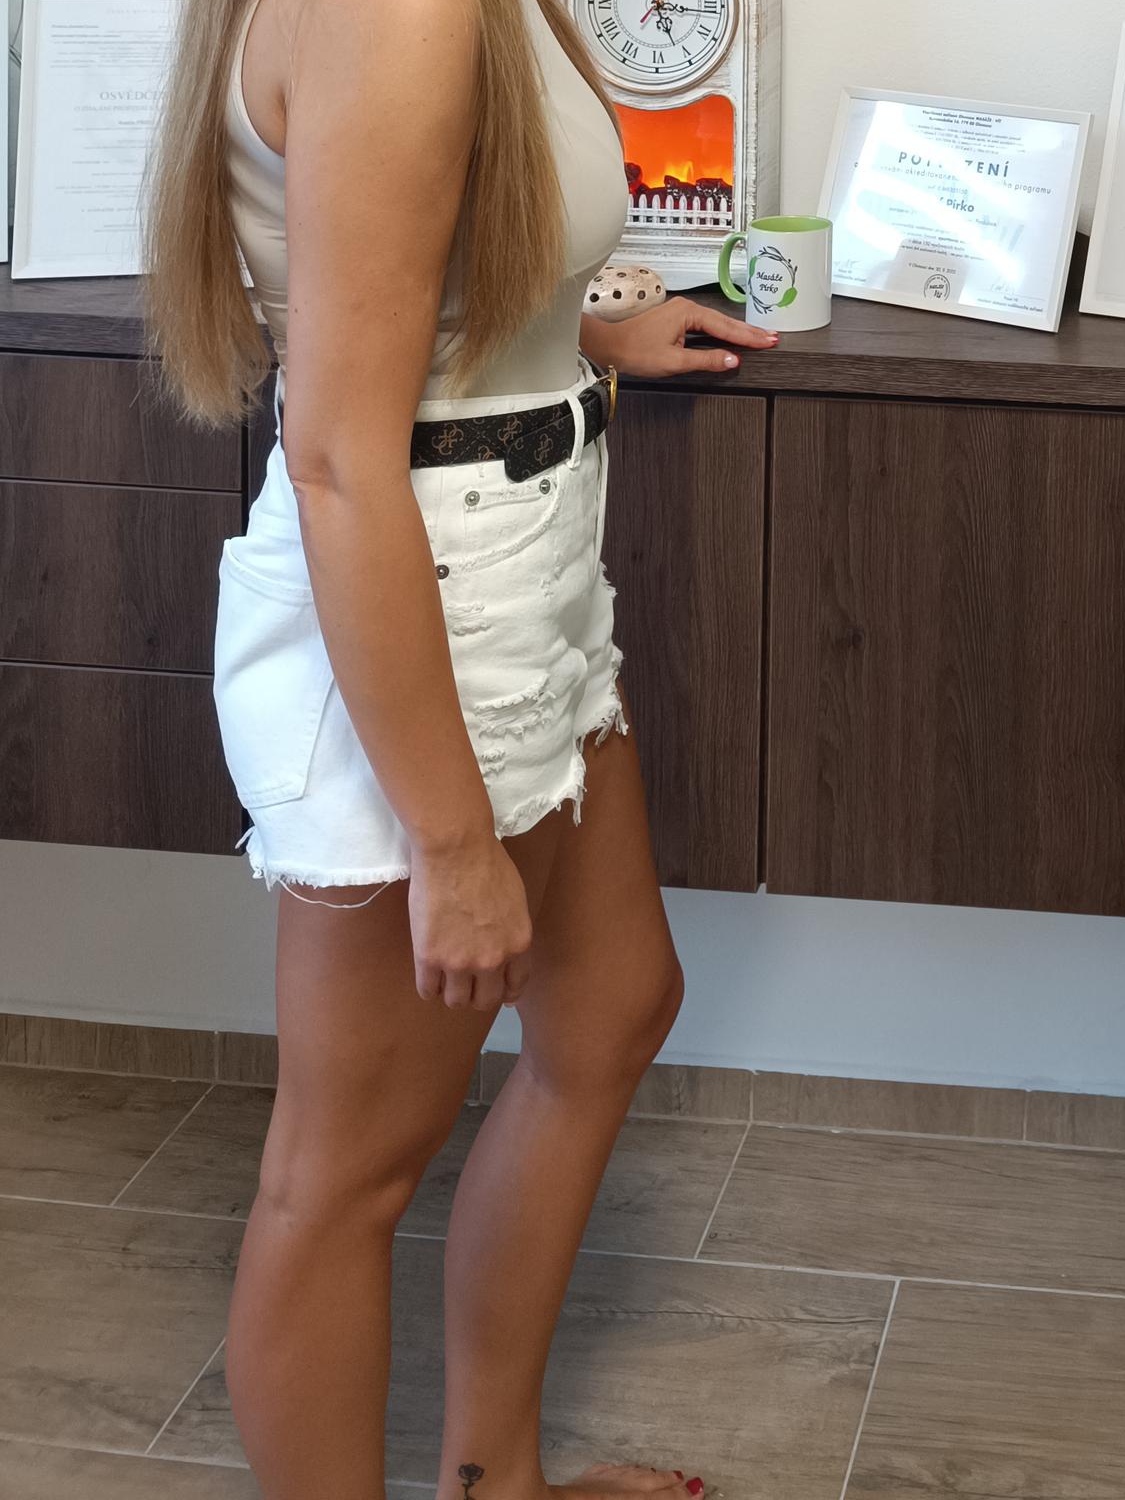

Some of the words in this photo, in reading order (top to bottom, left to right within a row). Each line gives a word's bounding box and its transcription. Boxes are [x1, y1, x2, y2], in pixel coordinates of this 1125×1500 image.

[704, 0, 717, 14] III
[600, 17, 621, 41] VIII
[697, 24, 711, 41] IV
[621, 40, 639, 59] VII
[682, 45, 691, 58] V
[652, 50, 665, 64] VI
[1014, 183, 1052, 195] programu
[946, 198, 975, 213] Pírko
[756, 272, 783, 282] Masáže
[759, 284, 779, 294] Pírko
